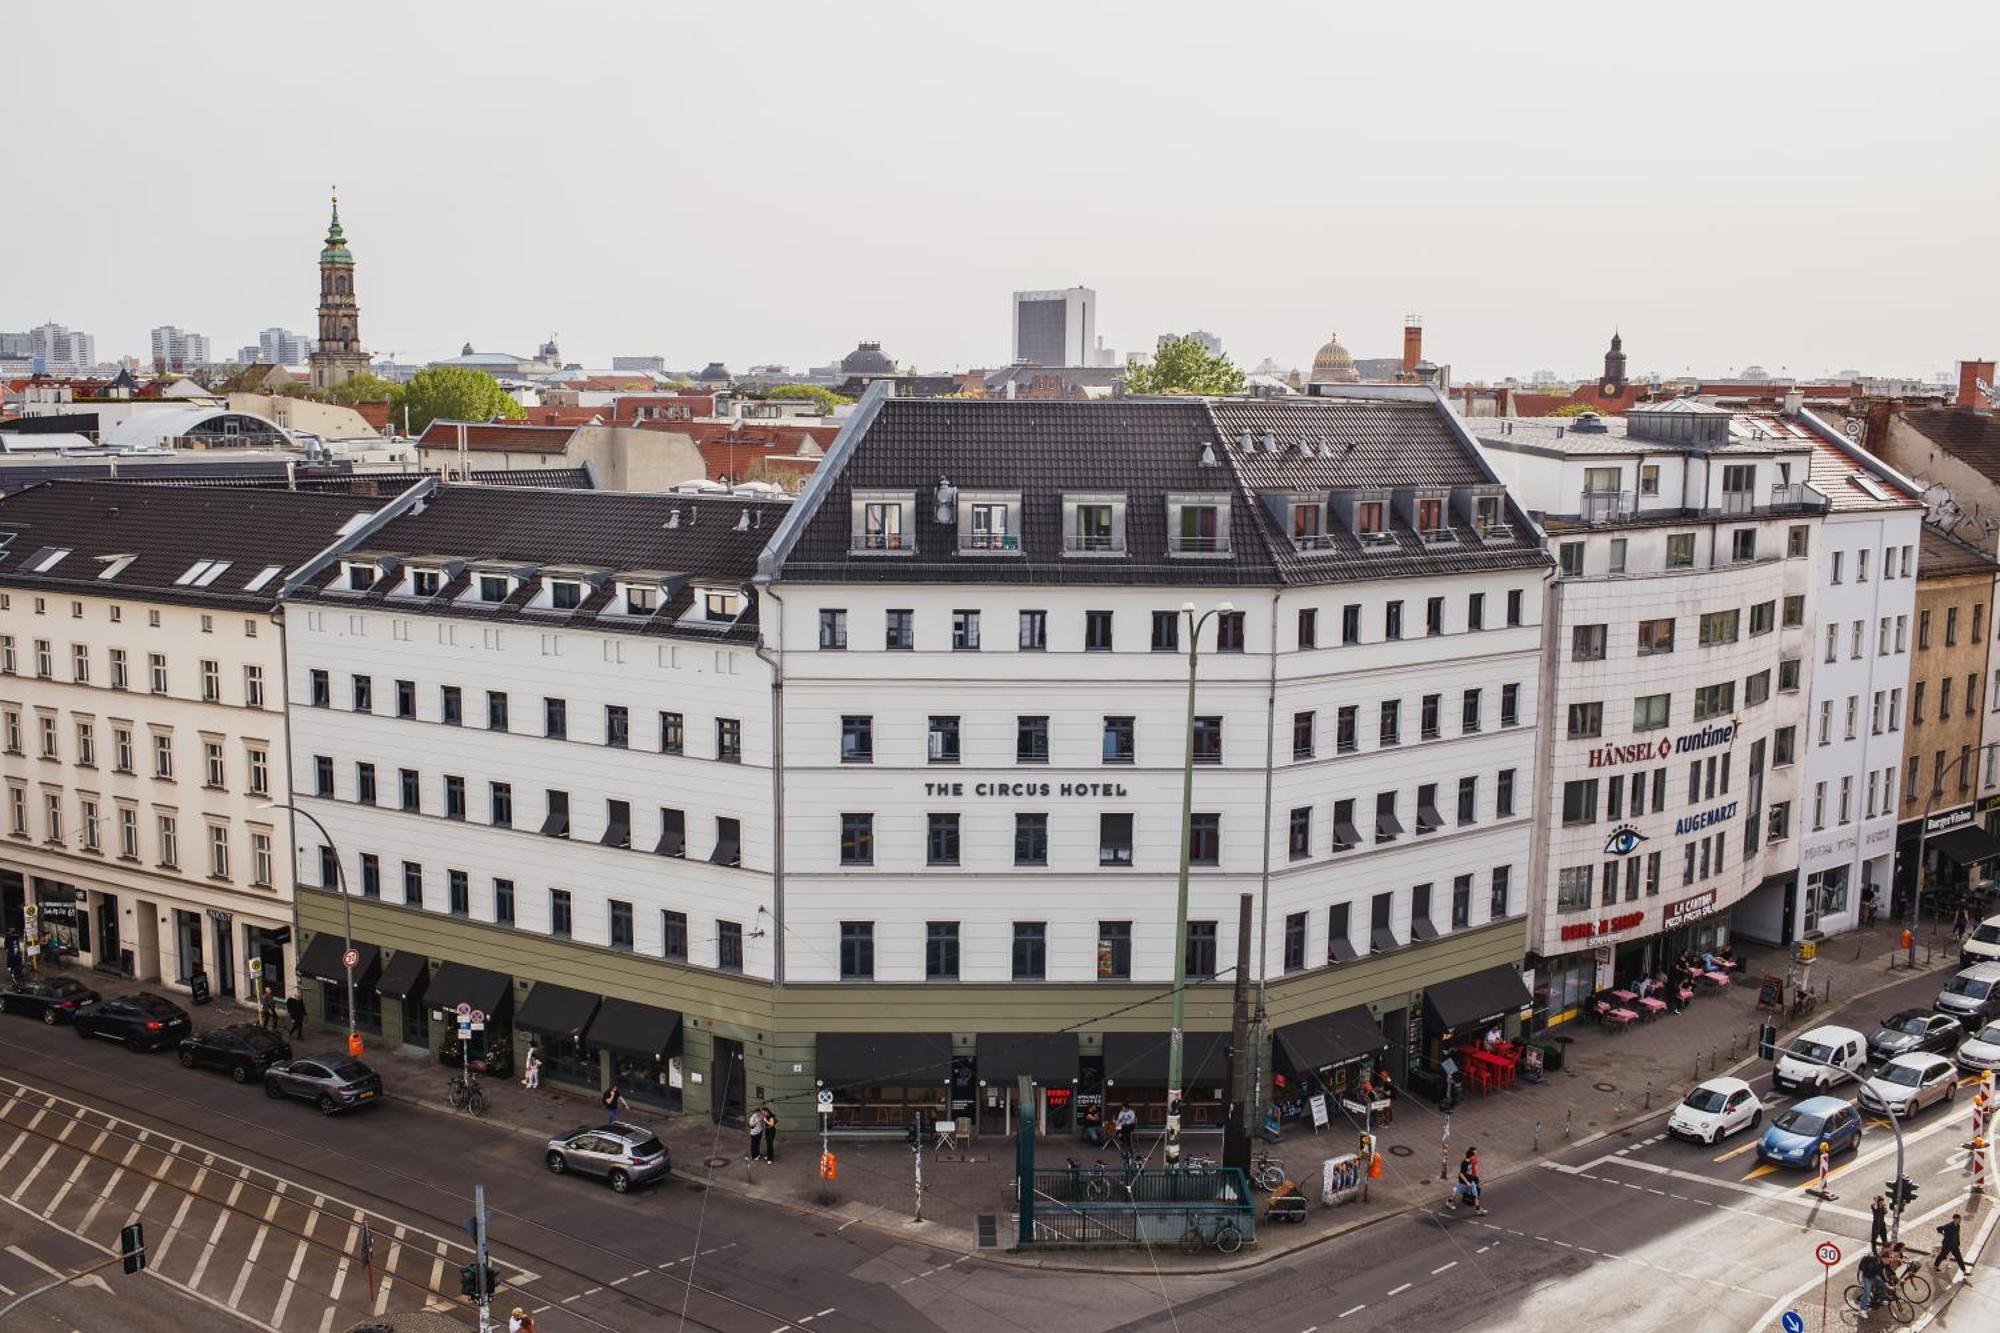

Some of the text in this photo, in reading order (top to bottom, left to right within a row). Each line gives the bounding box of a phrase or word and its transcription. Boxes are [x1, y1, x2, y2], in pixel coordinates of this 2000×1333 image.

[1676, 724, 1732, 754] runtime
[1588, 742, 1657, 768] HÄNSEL
[925, 783, 1128, 796] THE CIRCUS HOTEL
[1675, 801, 1738, 836] AUGENARZT
[1674, 902, 1685, 916] LA
[1610, 910, 1645, 932] SHOP
[1665, 914, 1682, 929] PIZZA
[1820, 1248, 1837, 1261] 30
